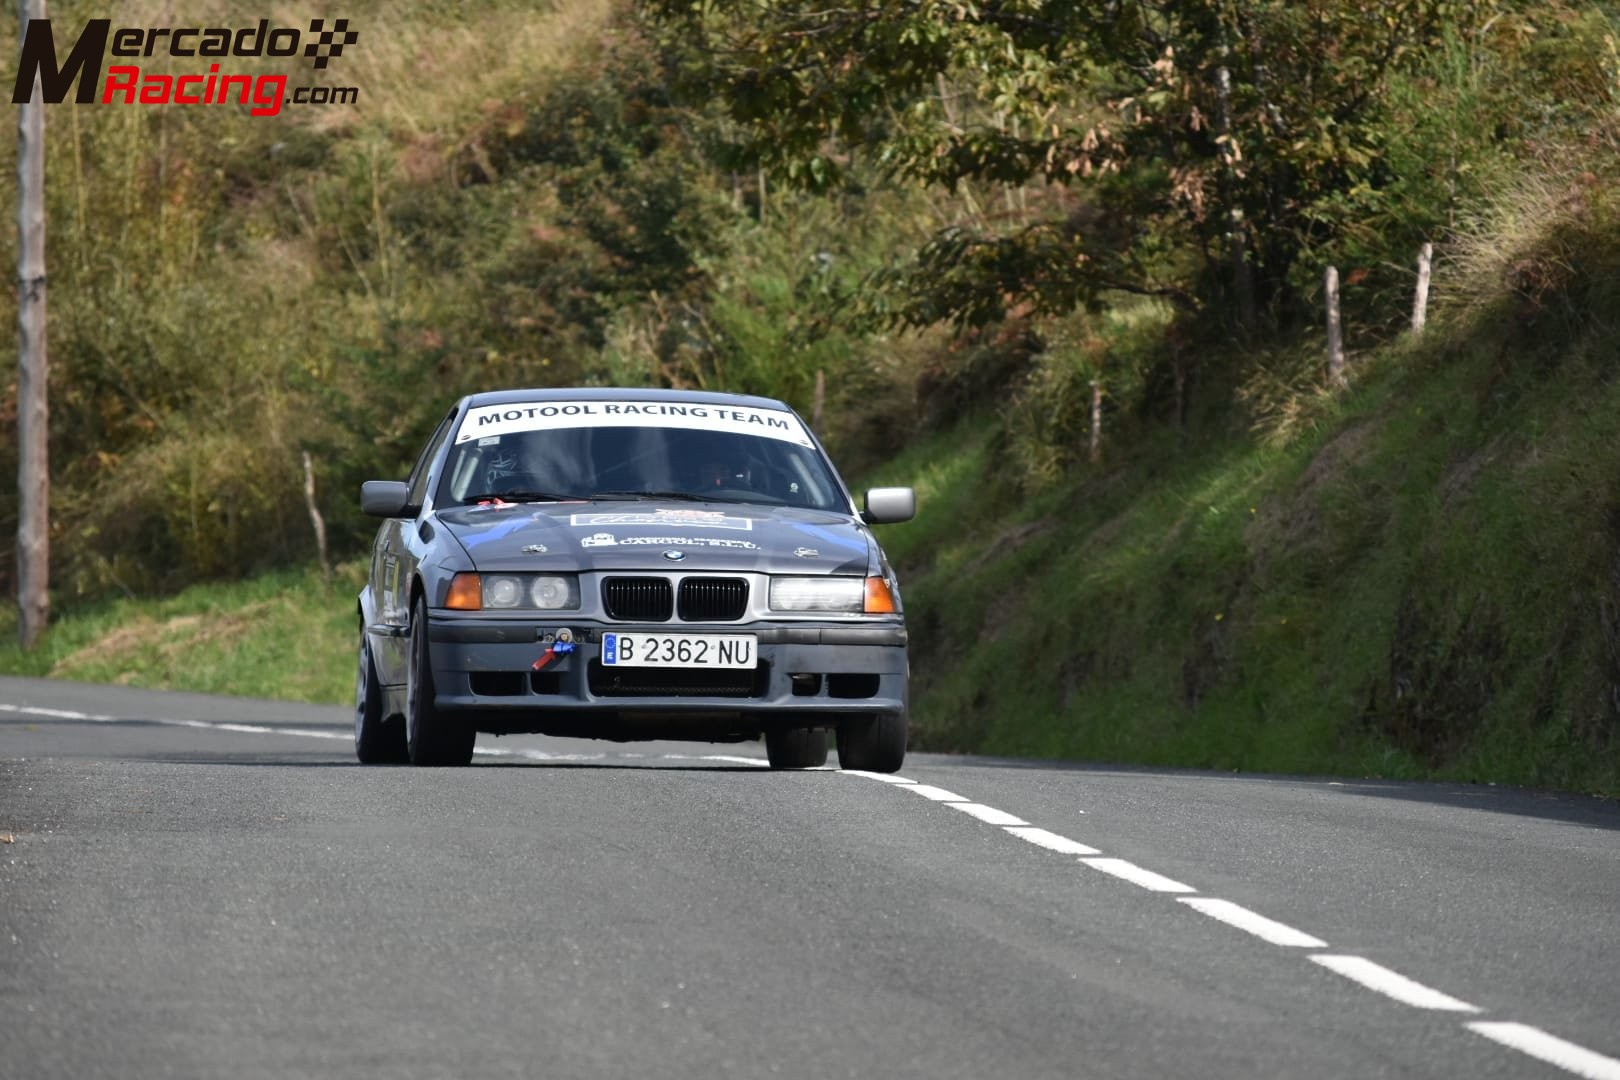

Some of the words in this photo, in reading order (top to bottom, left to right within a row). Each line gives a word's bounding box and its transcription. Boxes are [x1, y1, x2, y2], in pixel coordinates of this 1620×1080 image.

[478, 404, 597, 426] MOTOOL
[604, 404, 708, 418] RACING
[714, 409, 789, 430] TEAM
[620, 637, 634, 661] B
[644, 638, 708, 663] 2362
[718, 640, 750, 665] NU
